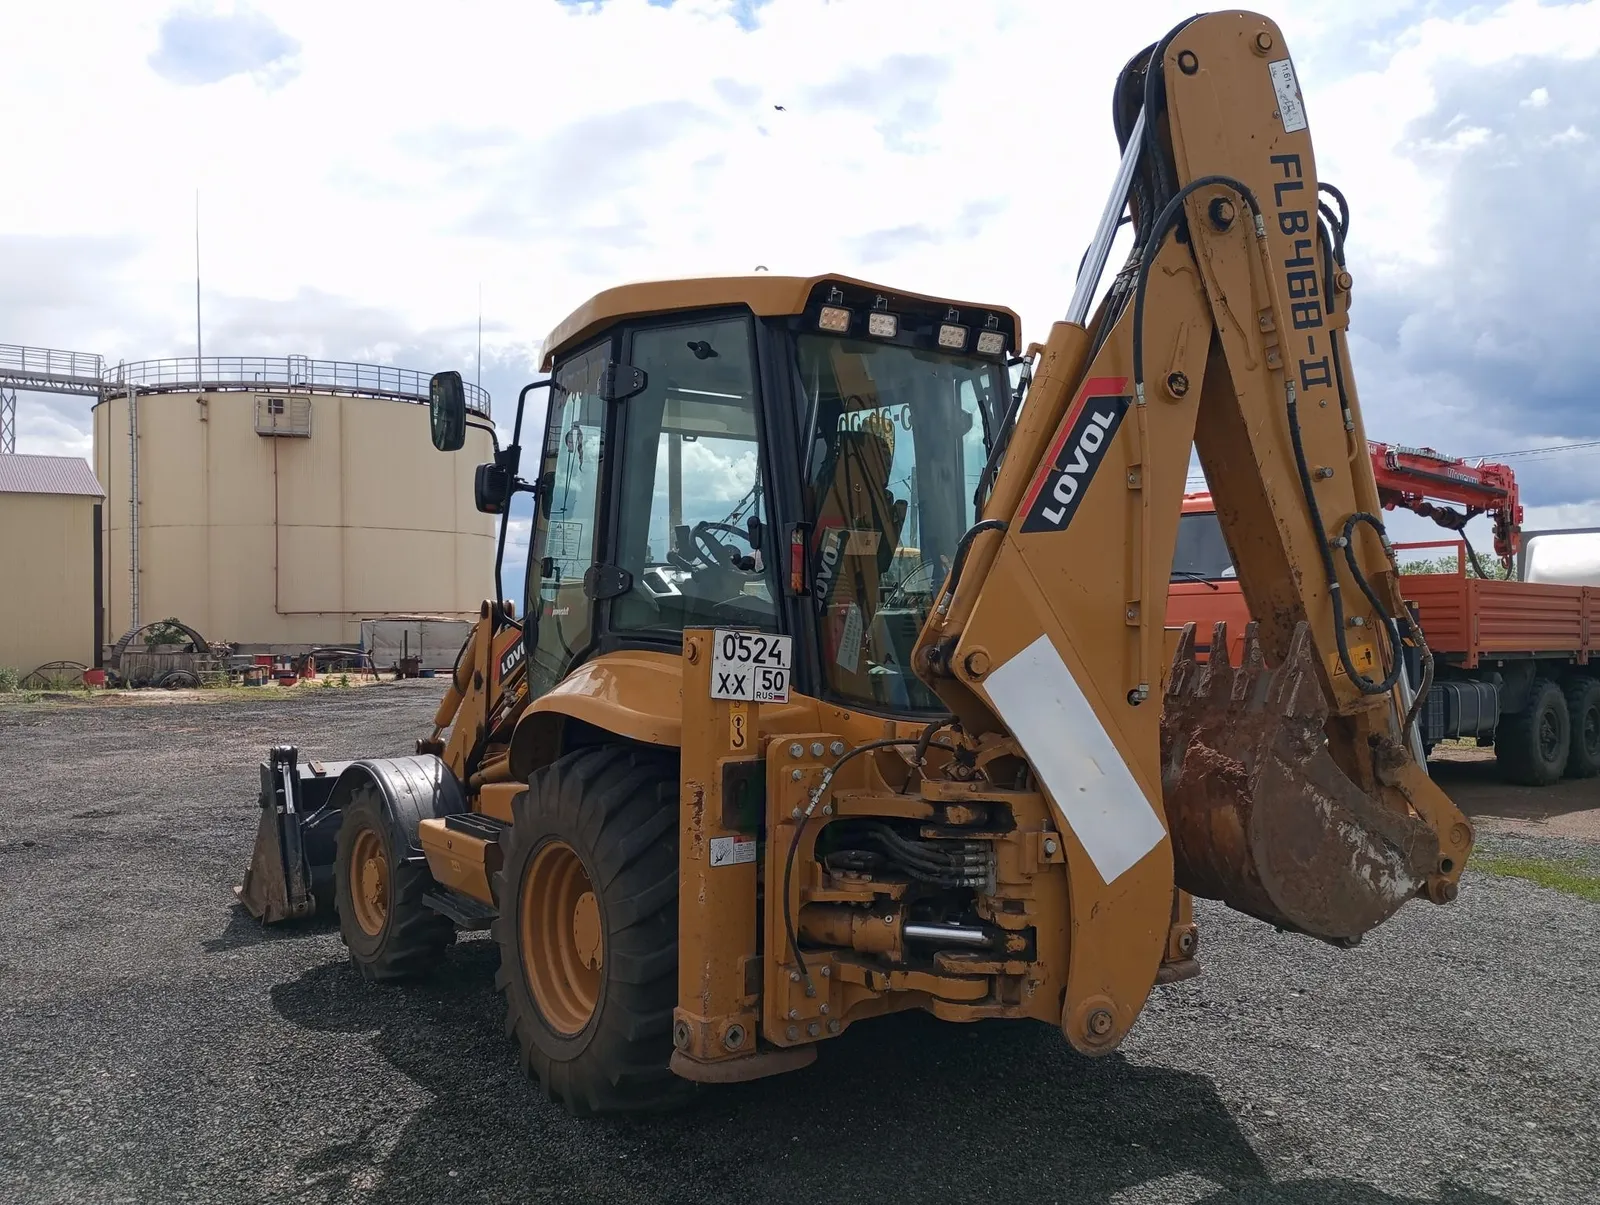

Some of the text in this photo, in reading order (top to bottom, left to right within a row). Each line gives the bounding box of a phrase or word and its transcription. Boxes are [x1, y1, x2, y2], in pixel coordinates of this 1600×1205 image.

[1041, 411, 1116, 525] LOVOL
[722, 634, 782, 666] 0524
[717, 672, 746, 696] XX
[761, 670, 784, 691] 50
[756, 691, 774, 700] RUS
